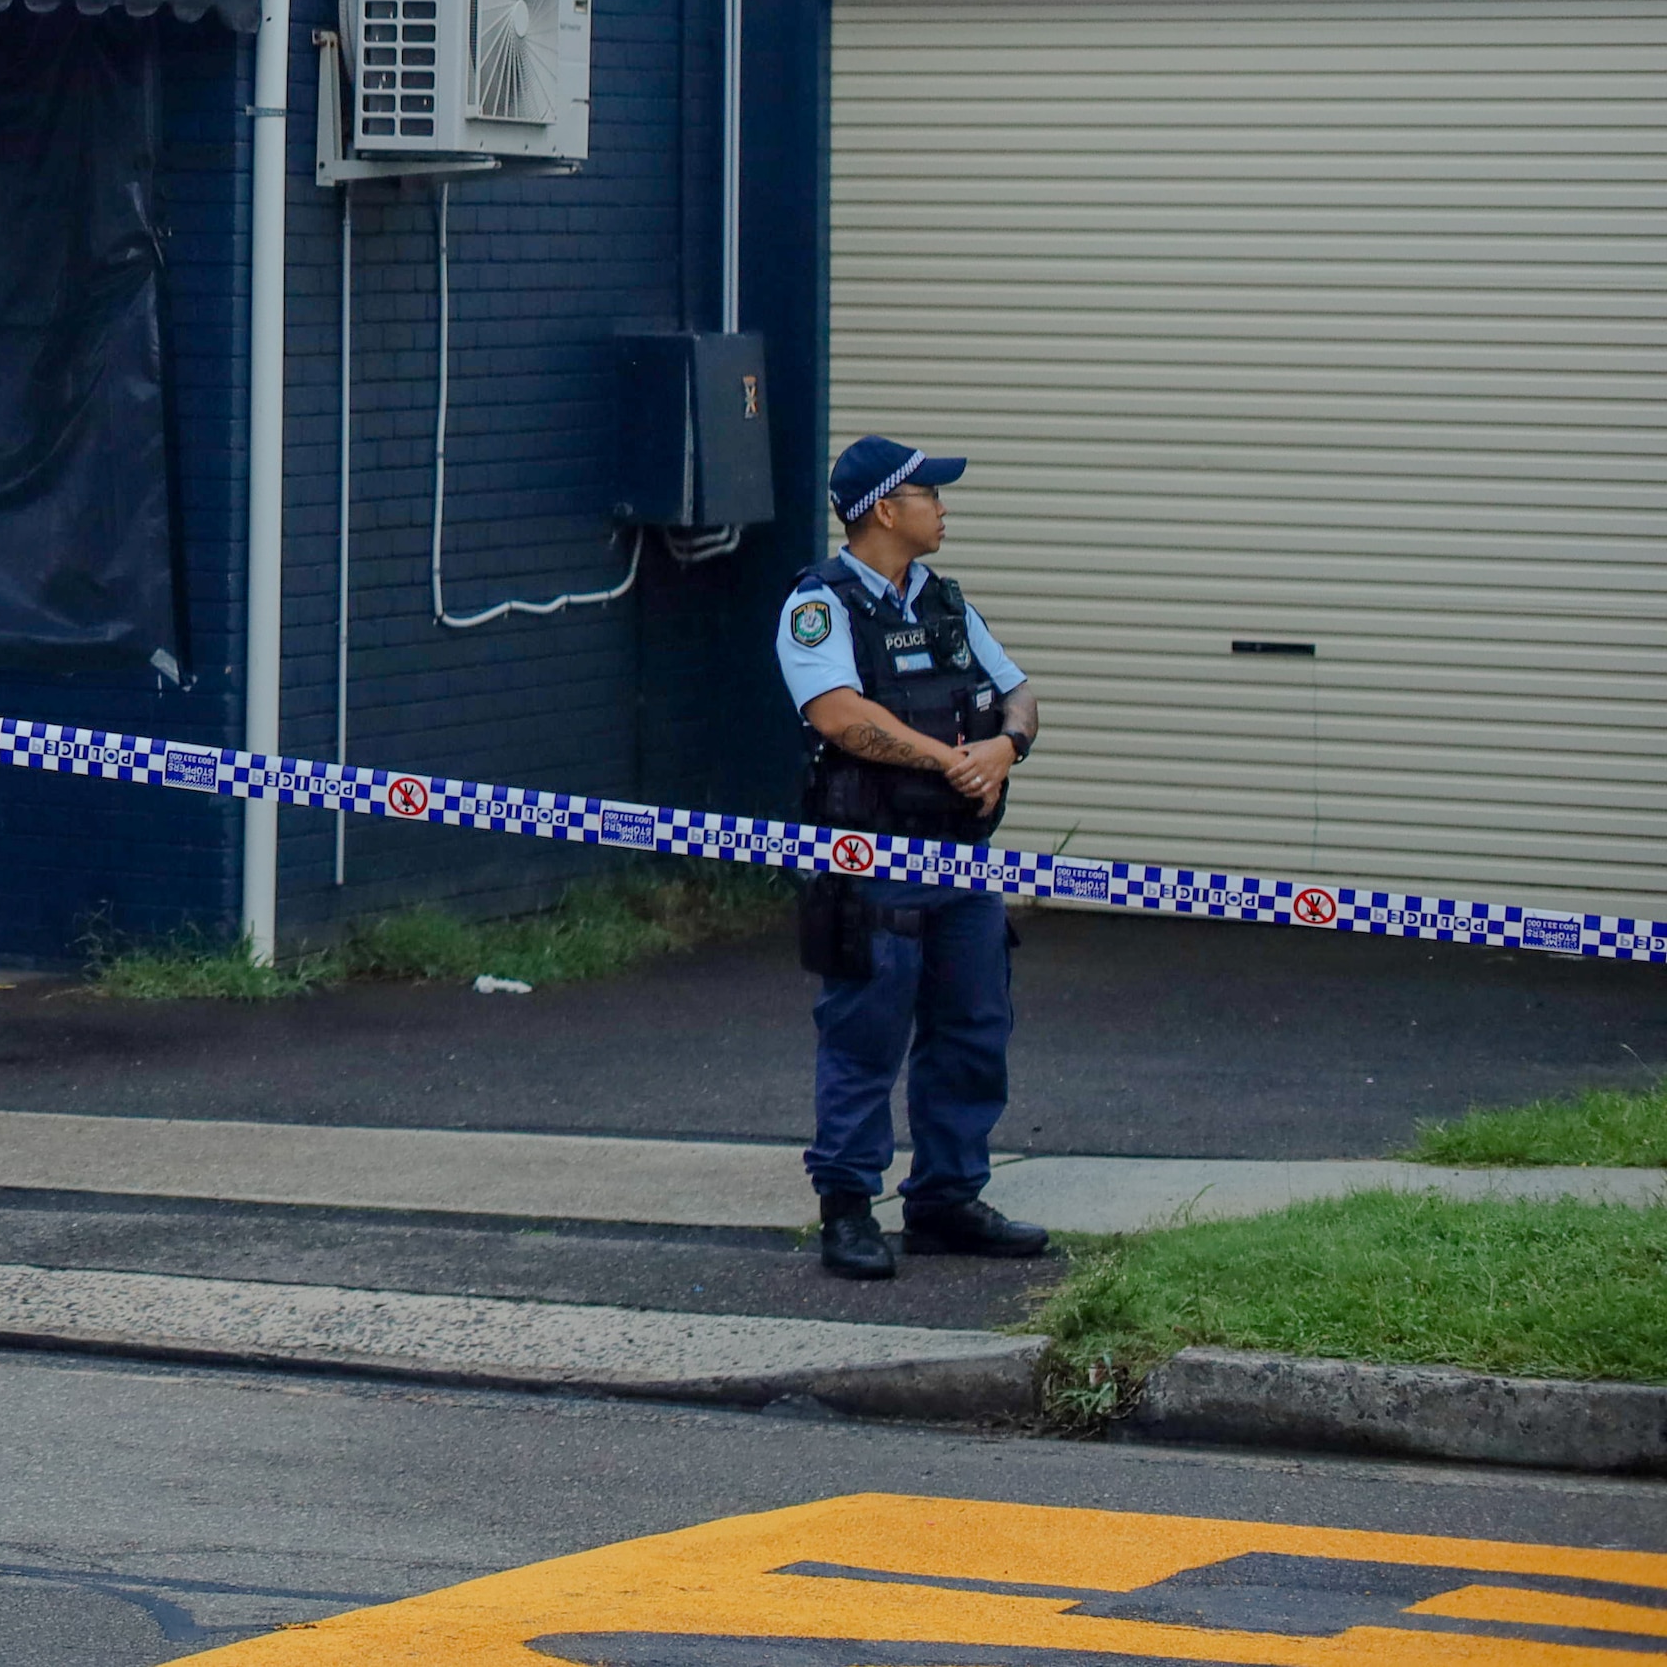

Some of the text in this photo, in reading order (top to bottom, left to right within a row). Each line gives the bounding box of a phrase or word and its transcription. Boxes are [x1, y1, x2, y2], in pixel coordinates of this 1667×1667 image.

[885, 633, 927, 651] POLICE
[46, 740, 133, 765] POLICE
[167, 763, 214, 775] STOPPERS
[183, 774, 213, 783] CRIME
[265, 772, 355, 796] POLICE
[477, 800, 567, 824] POLICE
[604, 823, 652, 835] STOPPERS
[706, 830, 798, 855] POLICE
[925, 857, 1018, 881] POLICE
[1057, 878, 1106, 889] STOPPERS
[1163, 885, 1256, 908] POLICE
[1390, 909, 1485, 933] POLICE
[1526, 929, 1577, 941] STOPPERS
